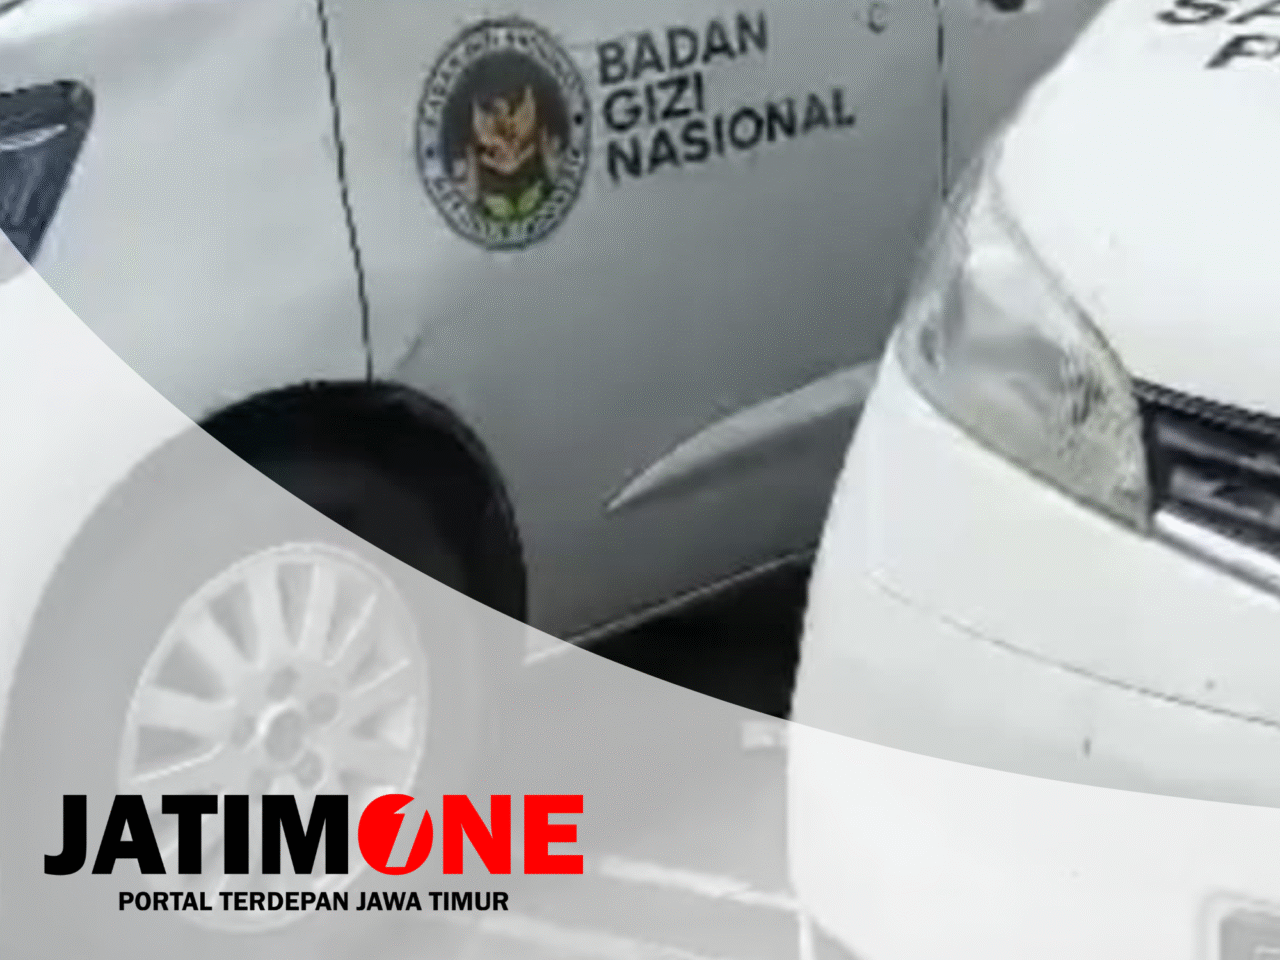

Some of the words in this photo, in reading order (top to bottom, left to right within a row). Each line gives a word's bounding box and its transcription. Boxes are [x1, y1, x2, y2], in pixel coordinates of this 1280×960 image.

[597, 10, 768, 86] BADAN
[602, 72, 706, 133] GIZI
[605, 88, 856, 185] NASIONAL
